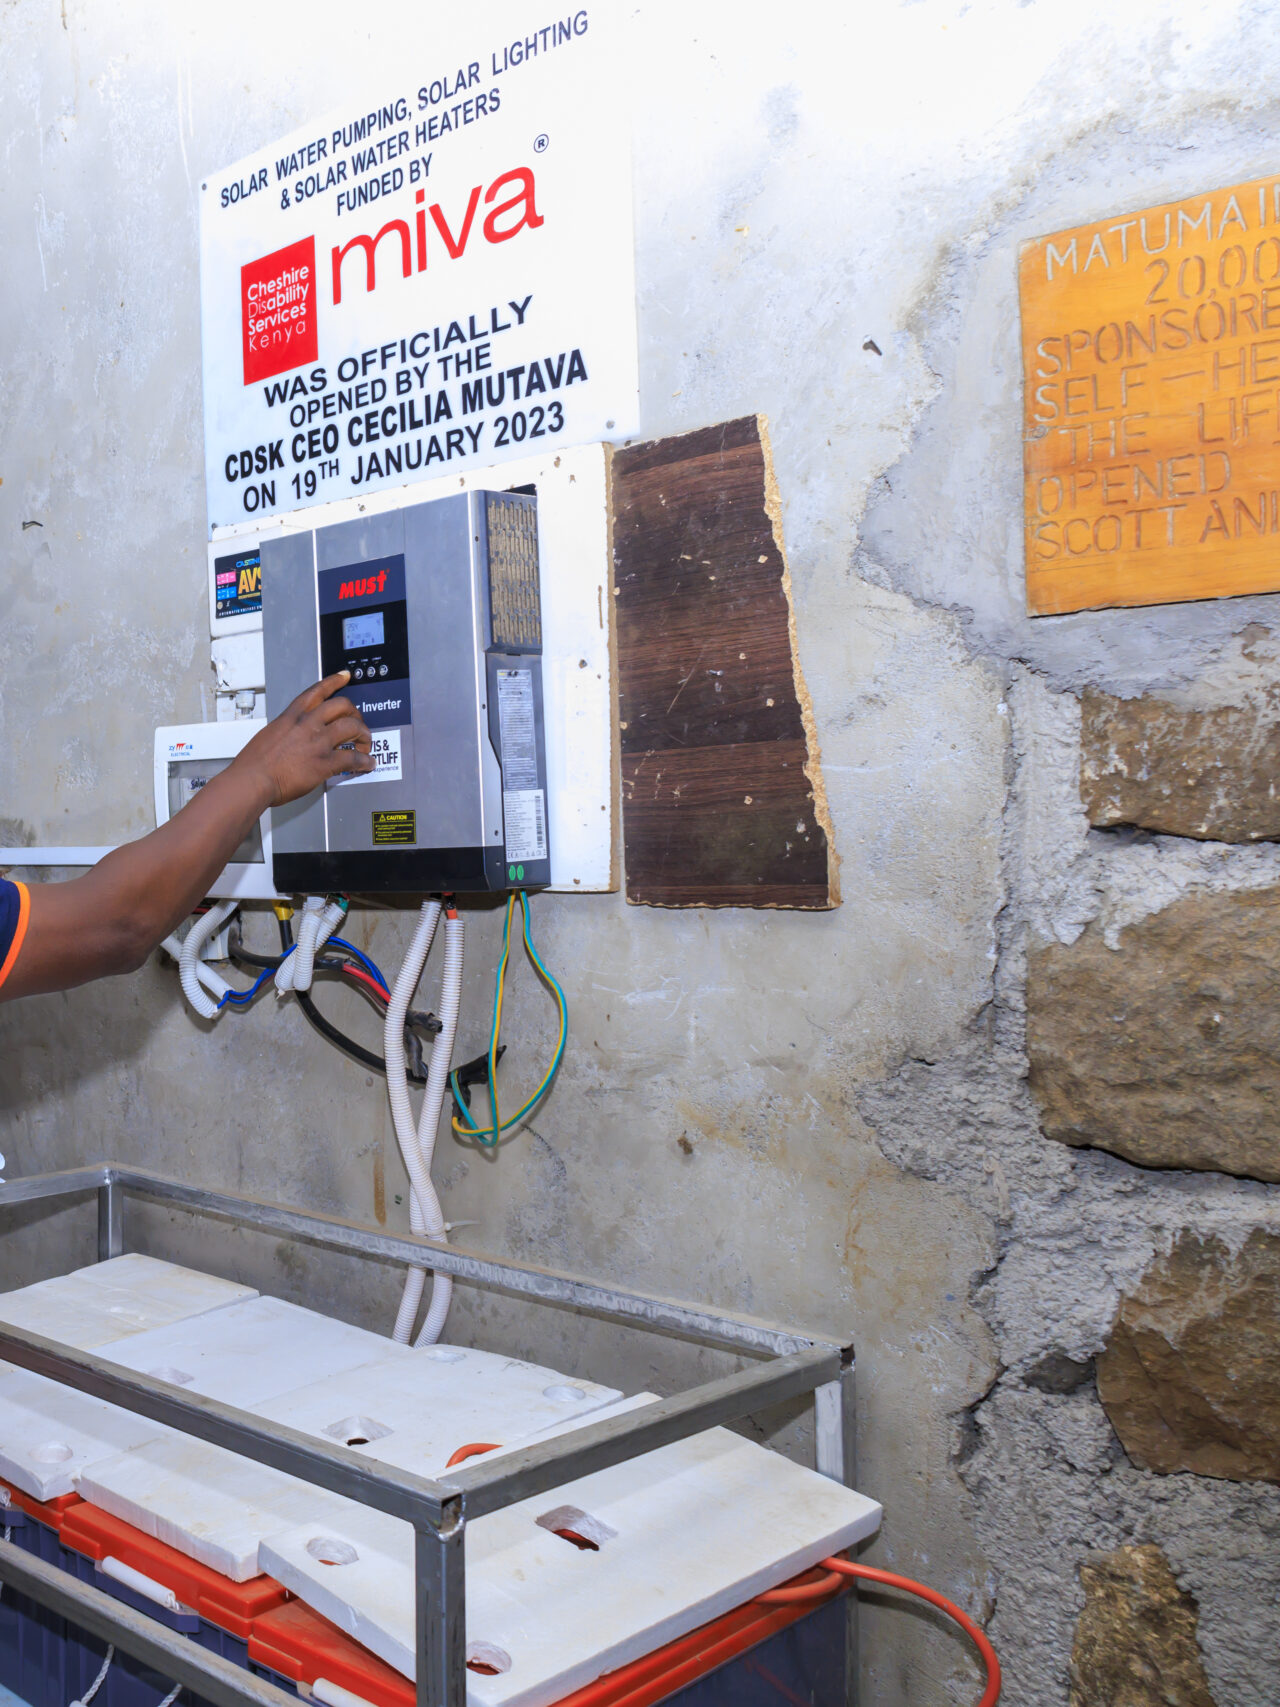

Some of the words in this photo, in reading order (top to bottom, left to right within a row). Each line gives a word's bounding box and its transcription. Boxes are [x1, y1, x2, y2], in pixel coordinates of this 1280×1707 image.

[220, 168, 268, 209] SOLAR
[275, 137, 328, 181] WATER
[332, 98, 413, 154] PUMPING,
[417, 62, 481, 111] SOLAR
[491, 10, 590, 76] LIGHTING
[280, 189, 291, 210] &
[294, 161, 348, 204] SOLAR
[351, 131, 410, 176] WATER
[415, 88, 501, 147] HEATERS
[336, 168, 405, 216] FUNDED
[408, 153, 433, 184] BY
[331, 166, 545, 306] miva
[247, 265, 309, 301] Cheshire
[248, 282, 310, 319] Disability
[248, 302, 307, 336] Services
[249, 320, 306, 353] Kenya
[263, 369, 328, 408] WAS
[337, 295, 534, 383] OFFICIALLY
[225, 440, 284, 482] CDSK
[291, 418, 339, 462] CEO
[347, 388, 452, 448] CECILIA
[461, 348, 589, 415] MUTAVA
[289, 378, 387, 428] OPENED
[395, 363, 430, 394] BY
[437, 342, 492, 382] THE
[243, 480, 276, 513] ON
[350, 421, 485, 485] JANUARY
[494, 400, 565, 448] 2023
[1060, 411, 1150, 465] THE
[1197, 390, 1280, 445] LIF
[1036, 450, 1232, 517] OPENED
[1035, 504, 1188, 560] SCOTT
[362, 699, 401, 712] Inverter
